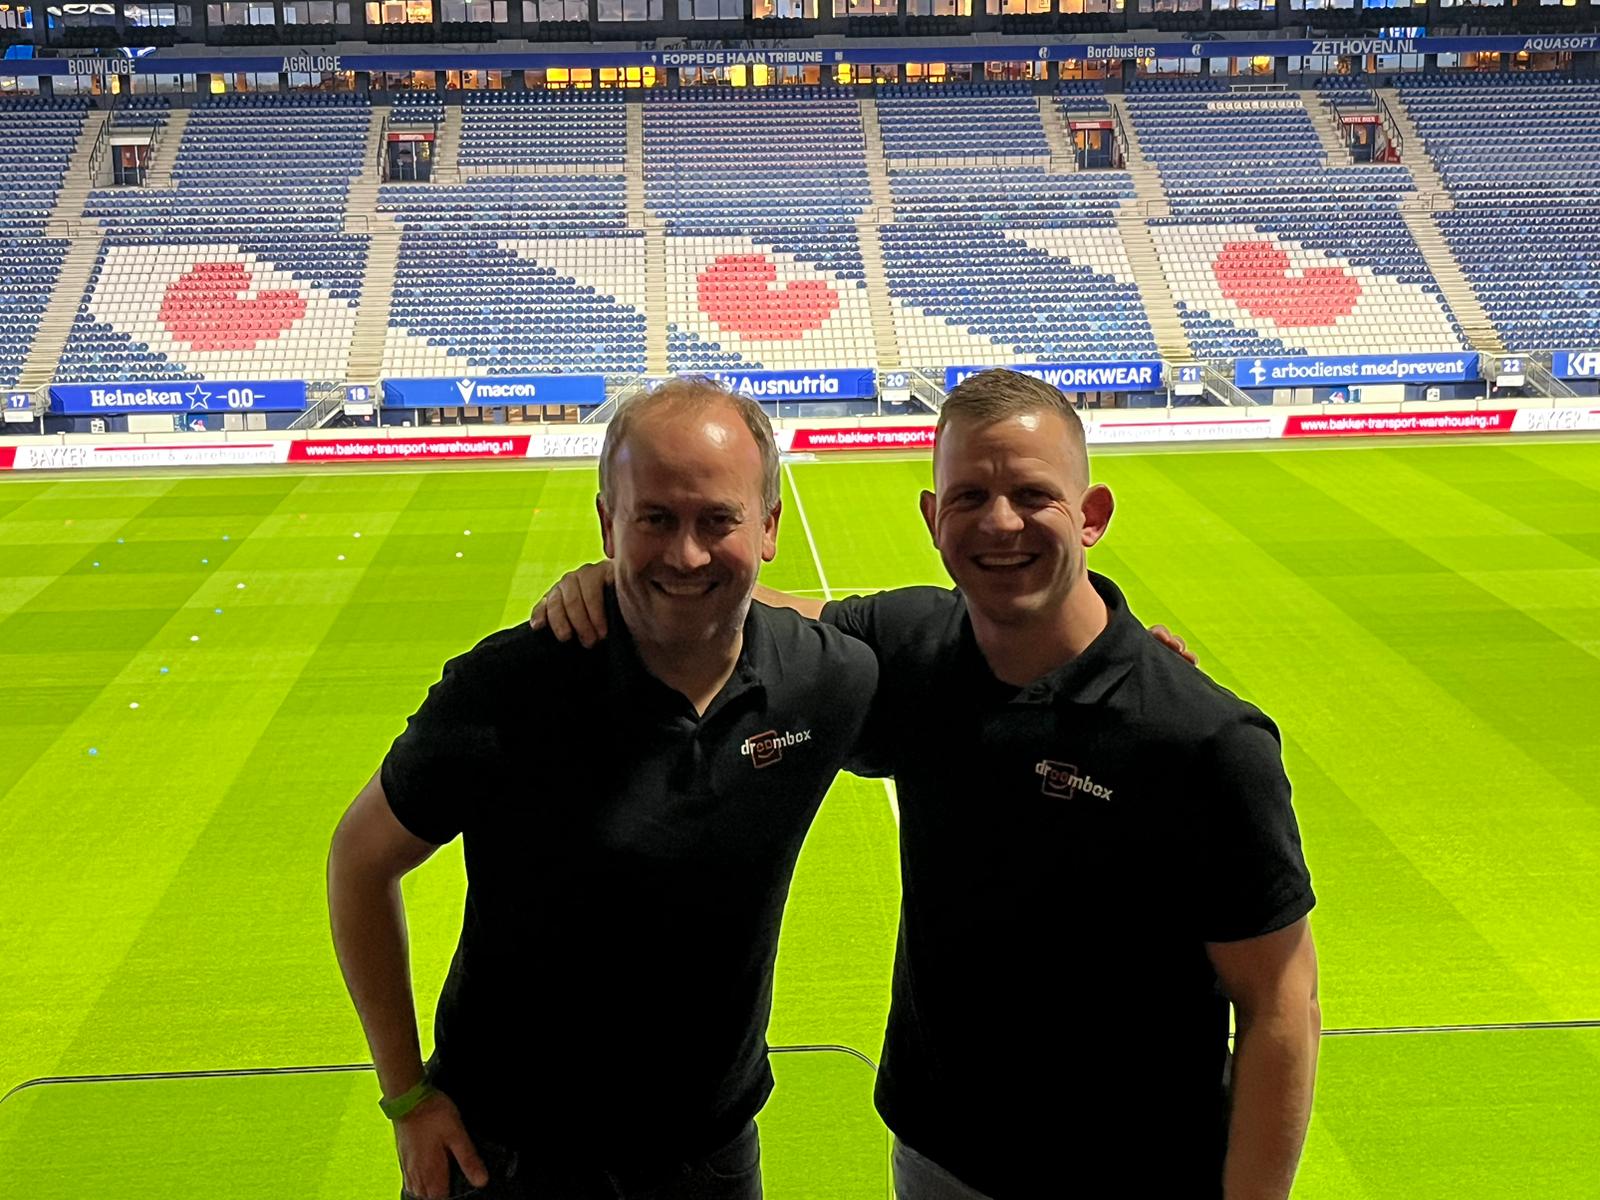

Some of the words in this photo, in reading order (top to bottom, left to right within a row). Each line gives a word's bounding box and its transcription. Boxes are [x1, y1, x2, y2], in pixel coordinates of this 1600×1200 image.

[1312, 39, 1418, 54] ZETHOVEN.NL
[1523, 36, 1597, 50] AQUASOFT
[662, 53, 704, 64] FOPPE
[706, 53, 724, 64] DE
[727, 52, 765, 64] HAAN
[767, 51, 823, 63] TRIBUNE
[1087, 45, 1156, 58] Bordbusters
[68, 59, 136, 75] BOUWLOGE
[282, 56, 342, 72] AGRILOGE
[1271, 363, 1358, 379] arbodienst
[1361, 359, 1464, 378] medprevent
[1503, 359, 1520, 372] 22
[886, 374, 904, 387] 20
[1043, 368, 1152, 386] WORKWEAR
[1182, 367, 1196, 381] 21
[476, 383, 535, 398] macron
[739, 376, 839, 396] Ausnutria
[10, 394, 26, 408] 17
[91, 389, 182, 407] Heineken
[349, 387, 366, 401] 18
[1301, 415, 1500, 431] www.bakker-transport-warehousing.nl
[306, 440, 514, 456] www.bakker-transport-warehousing.nl
[740, 729, 812, 756] droombox
[1035, 760, 1114, 801] droombox
